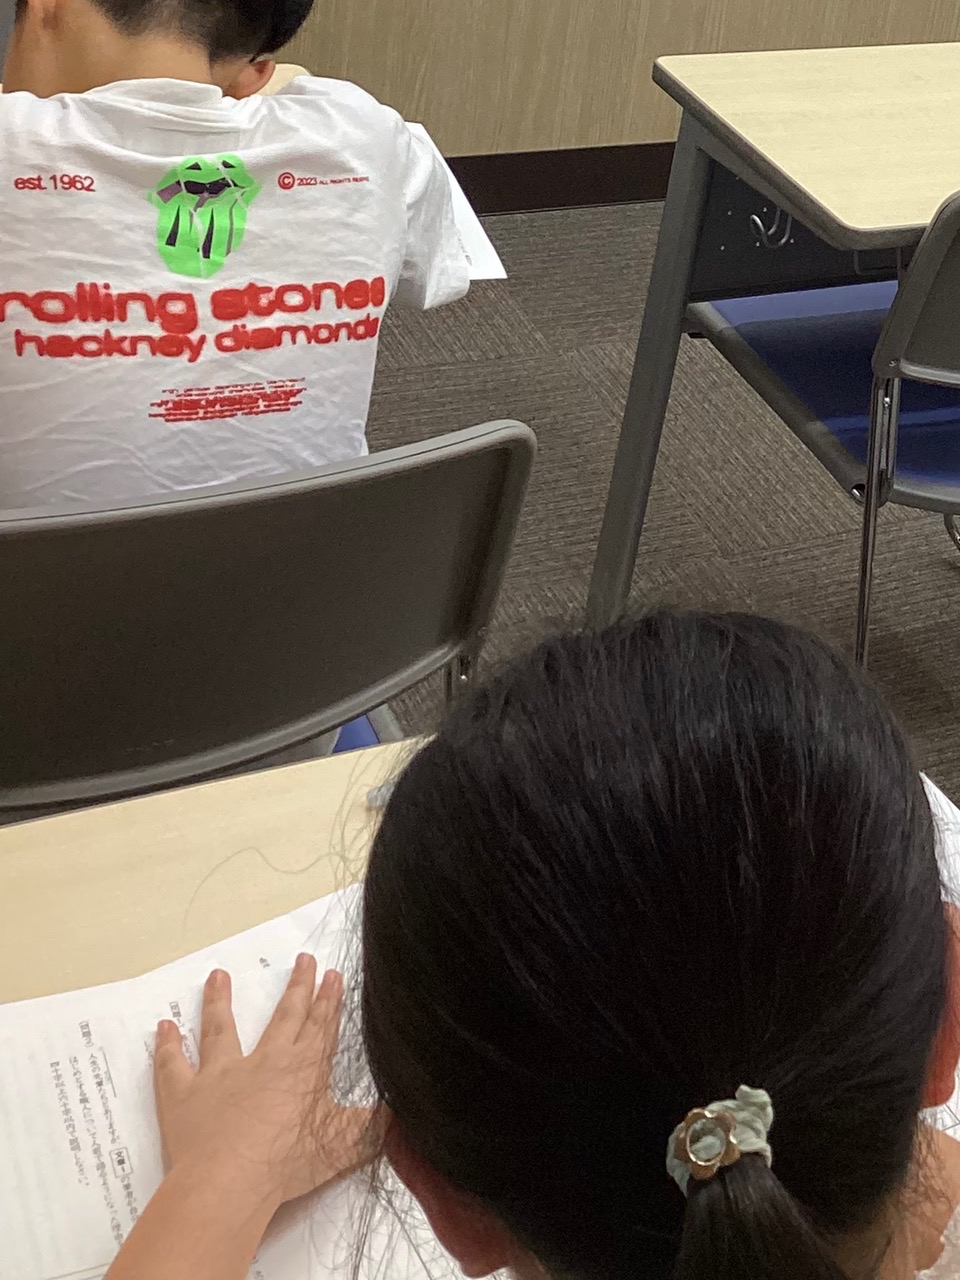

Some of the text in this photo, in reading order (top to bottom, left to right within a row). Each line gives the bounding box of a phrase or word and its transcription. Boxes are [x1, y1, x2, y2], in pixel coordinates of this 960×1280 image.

[49, 174, 96, 192] 1962
[0, 282, 199, 335] rolling
[15, 328, 206, 363] hackney
